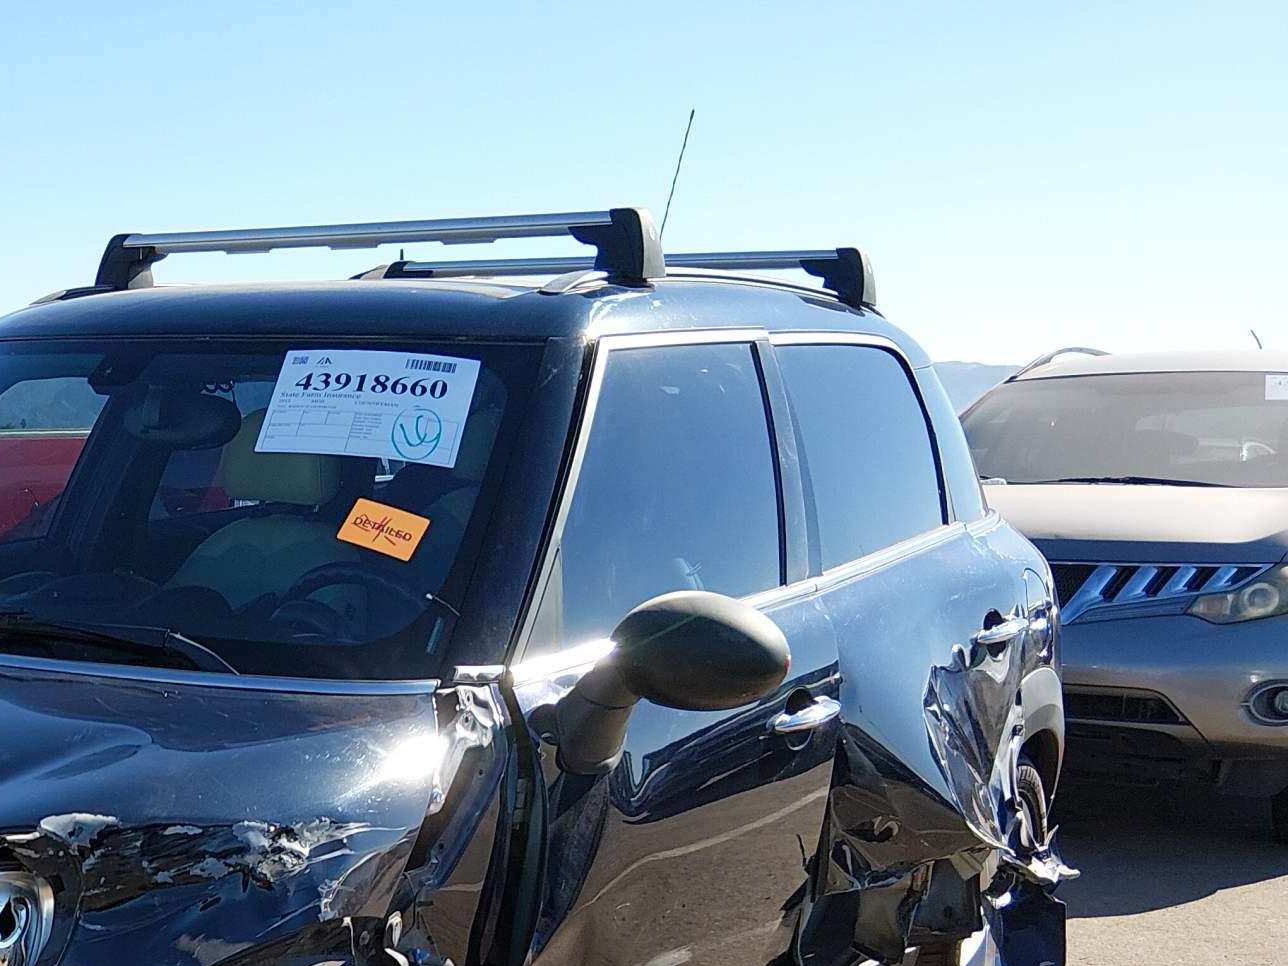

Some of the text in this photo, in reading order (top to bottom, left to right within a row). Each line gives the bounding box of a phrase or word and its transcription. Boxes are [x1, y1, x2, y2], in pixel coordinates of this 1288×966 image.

[295, 372, 448, 400] 43918660
[301, 391, 322, 399] Farm
[323, 391, 361, 400] Insurance
